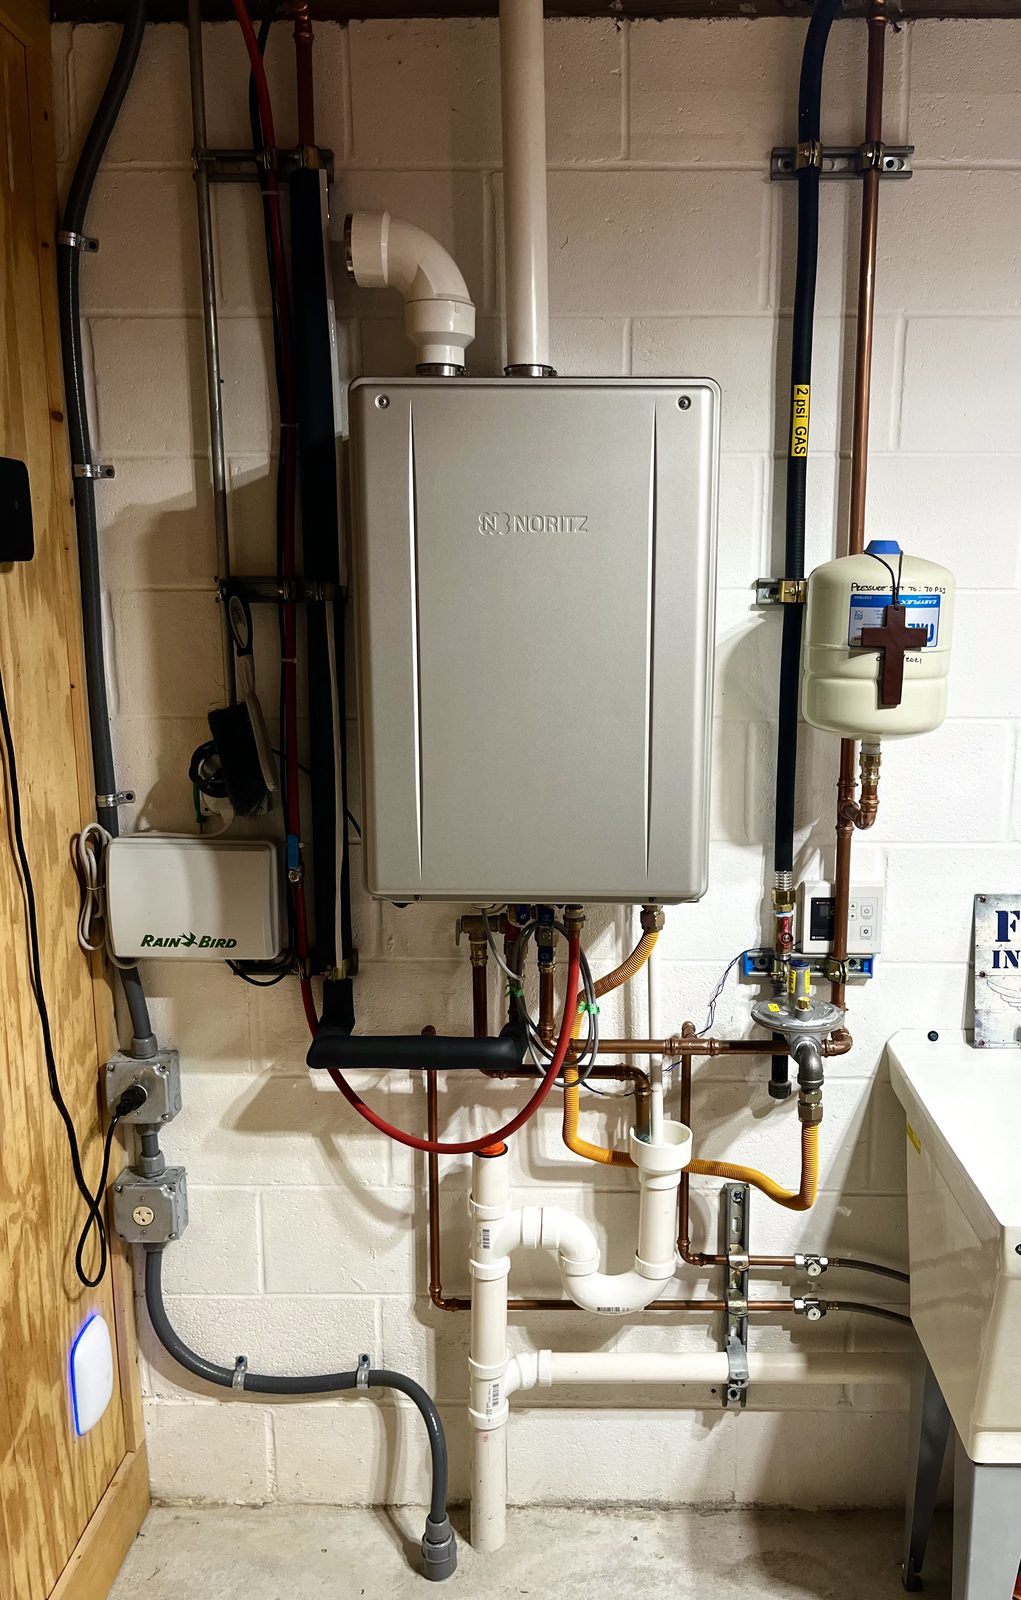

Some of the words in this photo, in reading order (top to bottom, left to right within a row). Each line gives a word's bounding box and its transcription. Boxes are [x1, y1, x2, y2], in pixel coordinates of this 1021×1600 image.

[796, 387, 809, 395] 2
[792, 399, 808, 418] psi
[793, 426, 807, 455] GAS
[513, 514, 588, 533] NORITZ
[141, 934, 182, 948] RAIN
[198, 935, 238, 948] BIRD
